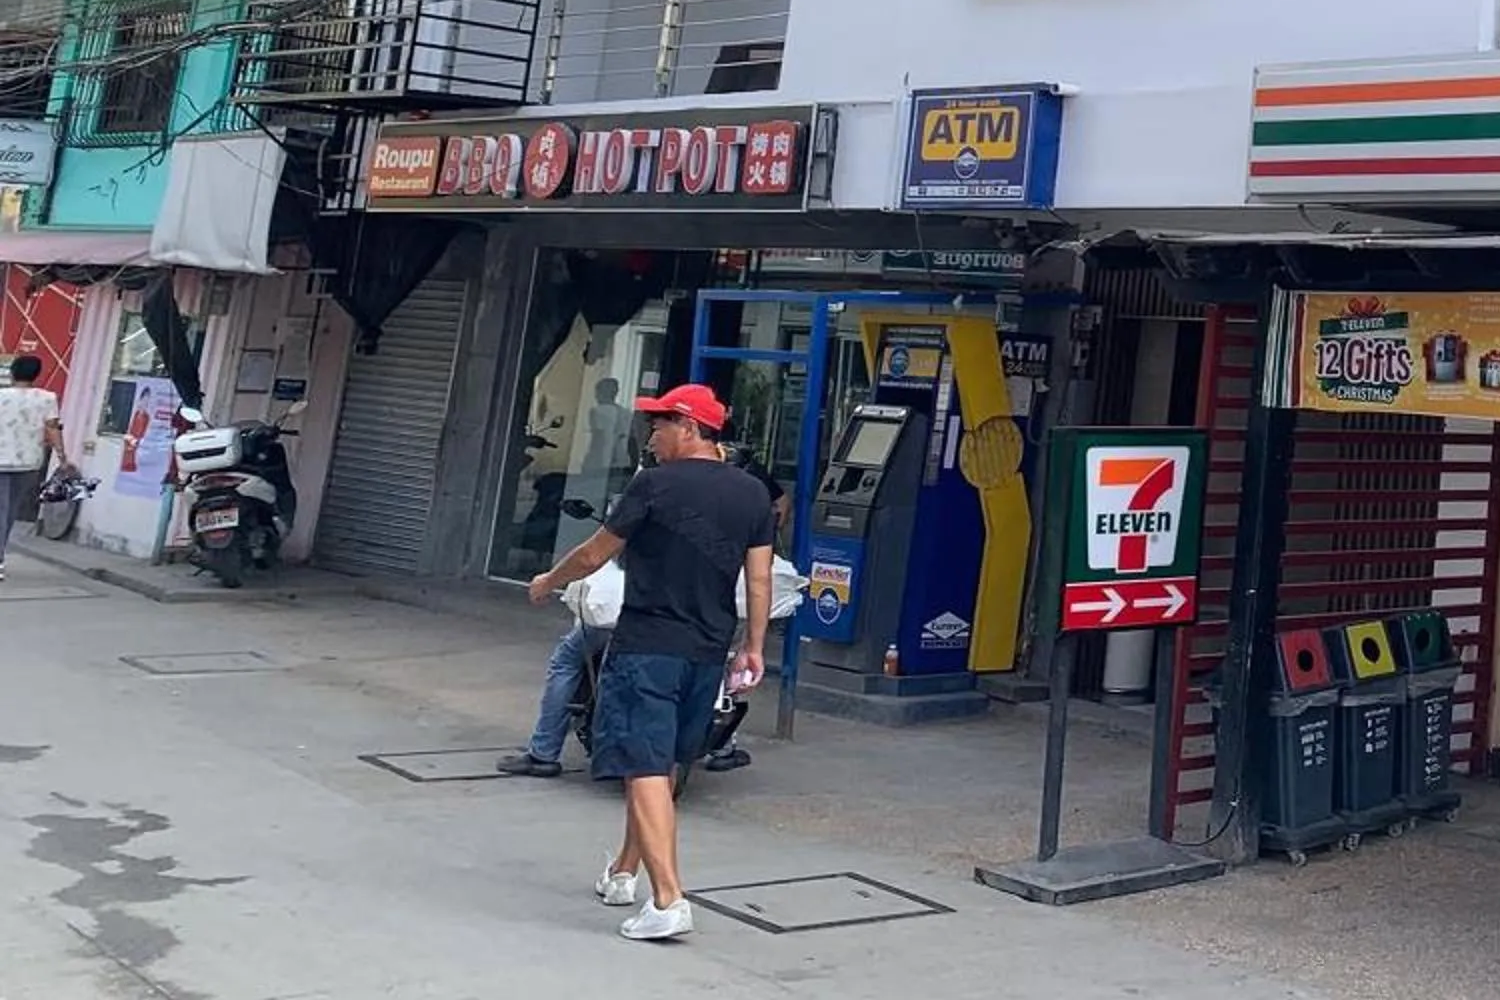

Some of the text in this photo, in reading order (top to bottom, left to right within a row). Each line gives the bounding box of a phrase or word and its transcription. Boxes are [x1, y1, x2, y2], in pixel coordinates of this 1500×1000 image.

[928, 112, 1014, 145] ATM
[374, 144, 434, 173] Roupu
[437, 134, 522, 194] BBQ
[1001, 340, 1047, 361] ATM
[1314, 336, 1413, 385] 12 Gifts
[1337, 385, 1394, 401] CHRISTMAS
[1099, 458, 1175, 570] 7
